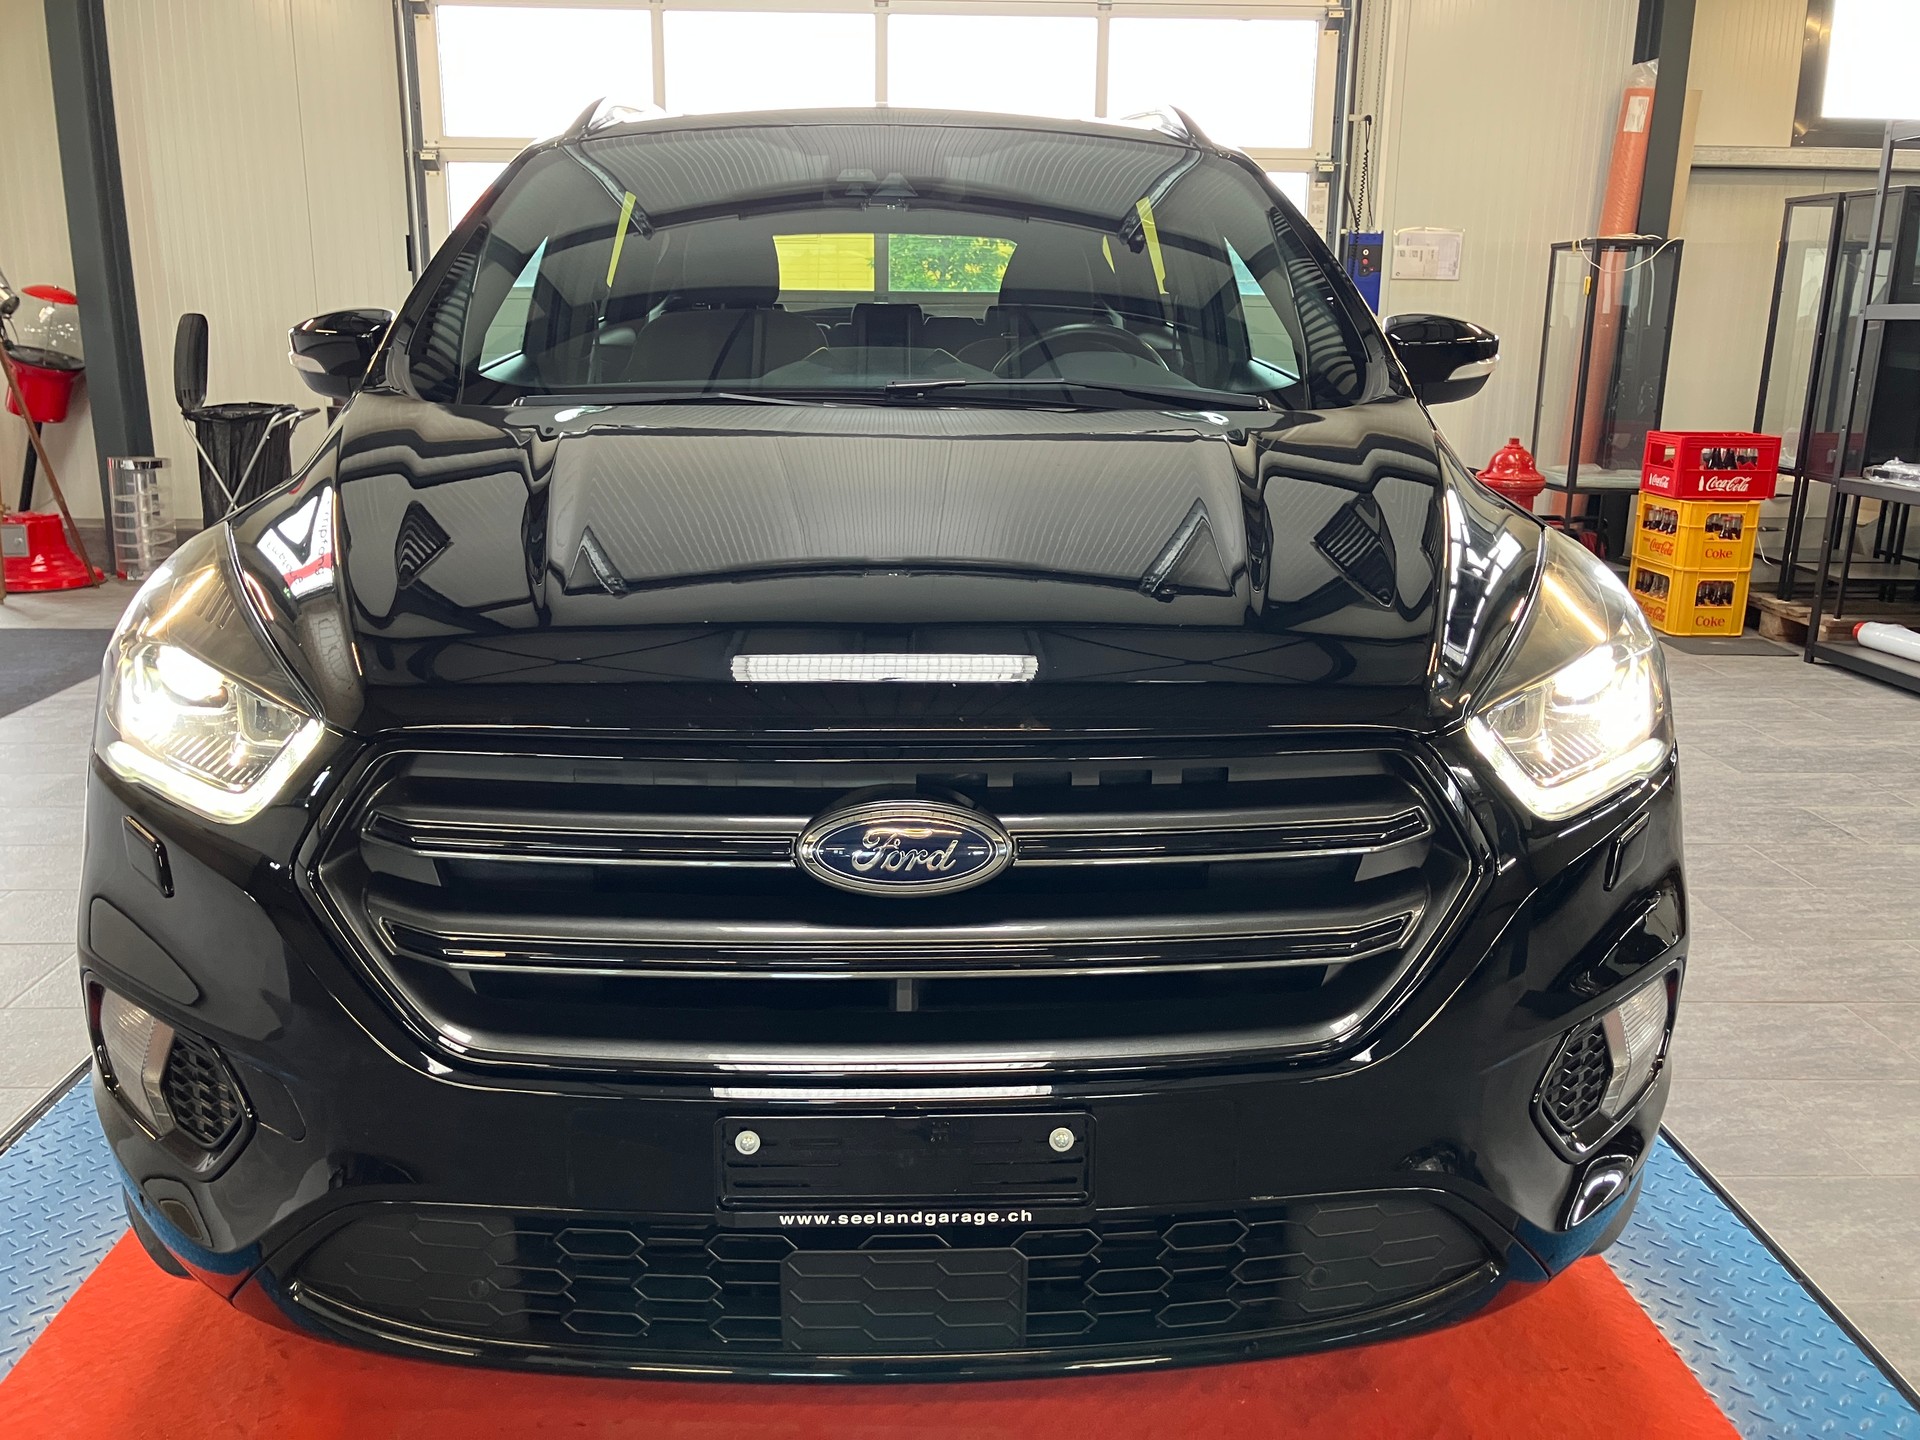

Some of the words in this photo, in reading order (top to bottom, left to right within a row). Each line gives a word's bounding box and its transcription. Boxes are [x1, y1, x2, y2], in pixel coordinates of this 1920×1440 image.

[1706, 476, 1752, 492] Coca-Cola
[1705, 548, 1733, 559] Coke
[1695, 615, 1725, 627] Coke
[851, 828, 959, 872] Ford
[779, 1209, 1033, 1226] www.seelandgarage.ch
